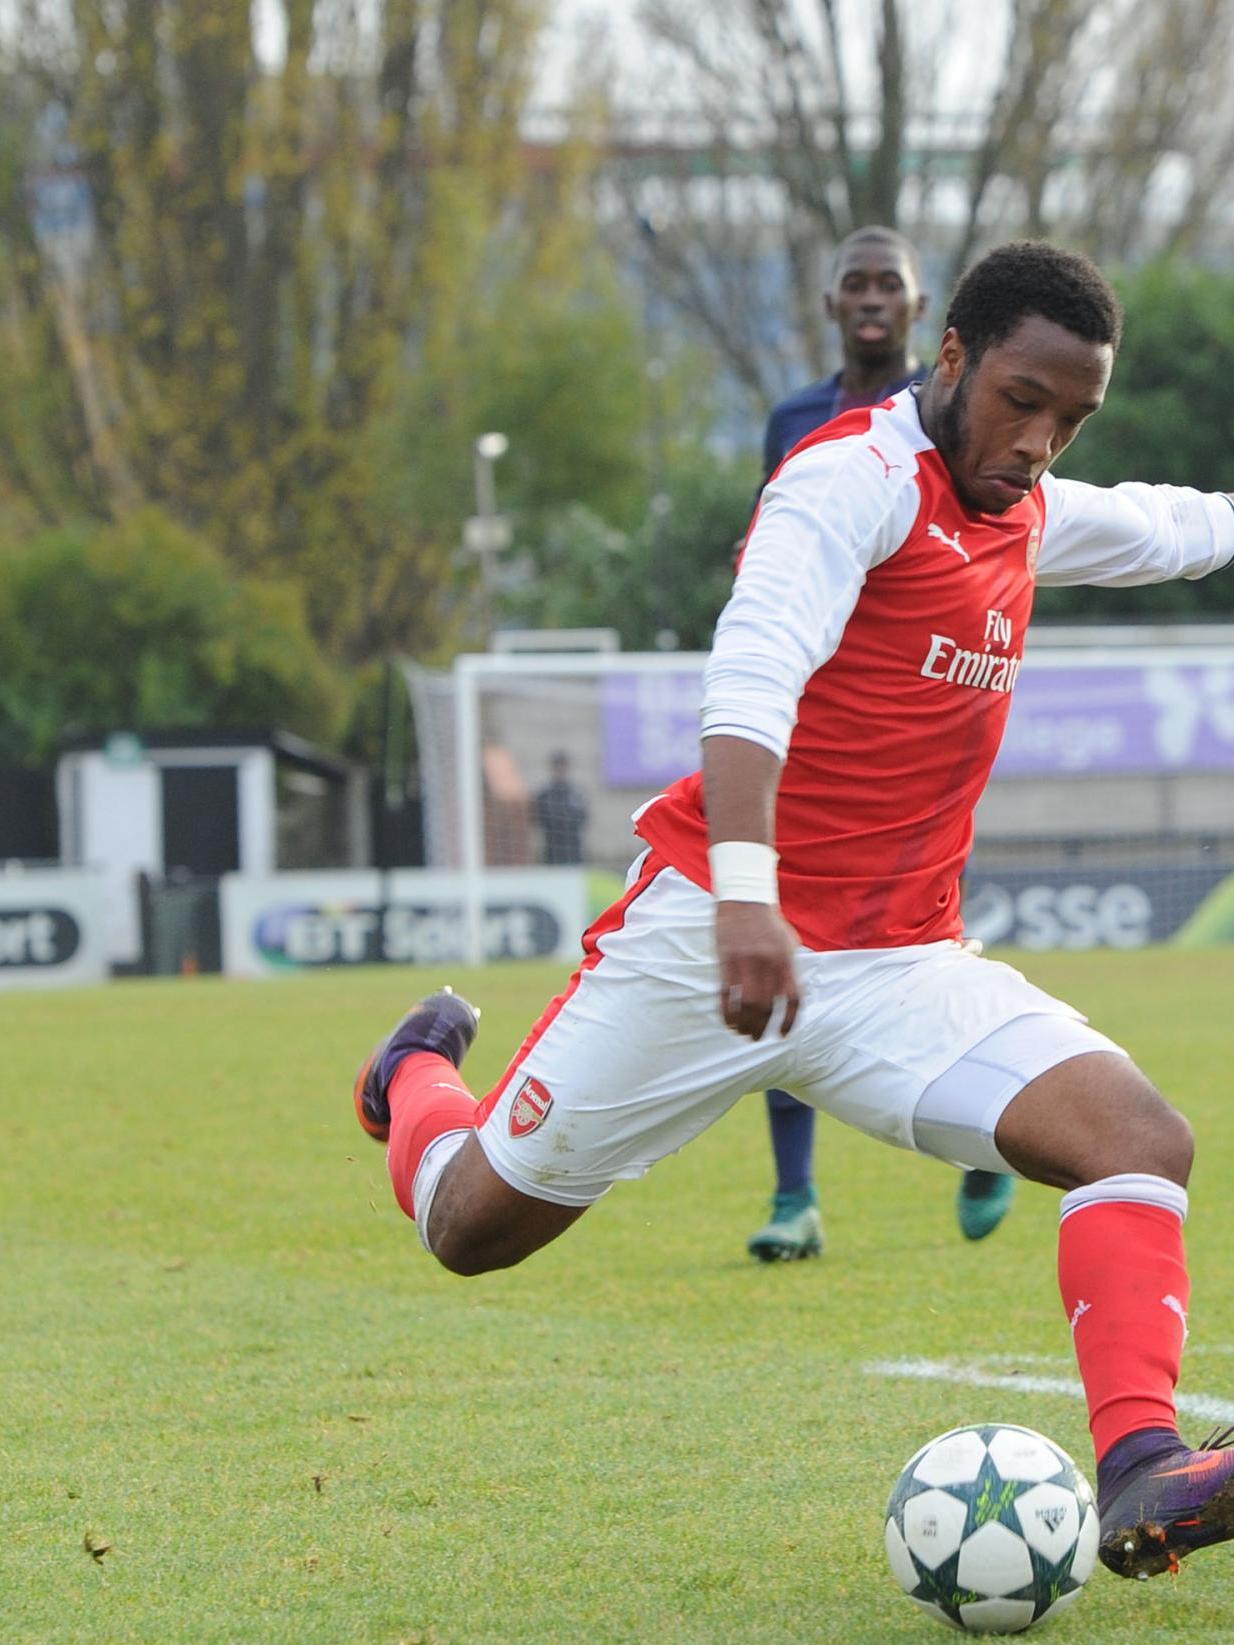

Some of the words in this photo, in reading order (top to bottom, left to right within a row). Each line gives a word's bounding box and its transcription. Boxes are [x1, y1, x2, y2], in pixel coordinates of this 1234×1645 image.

[984, 608, 1013, 650] Fly
[920, 633, 1021, 693] Emirat
[286, 910, 380, 962] BT
